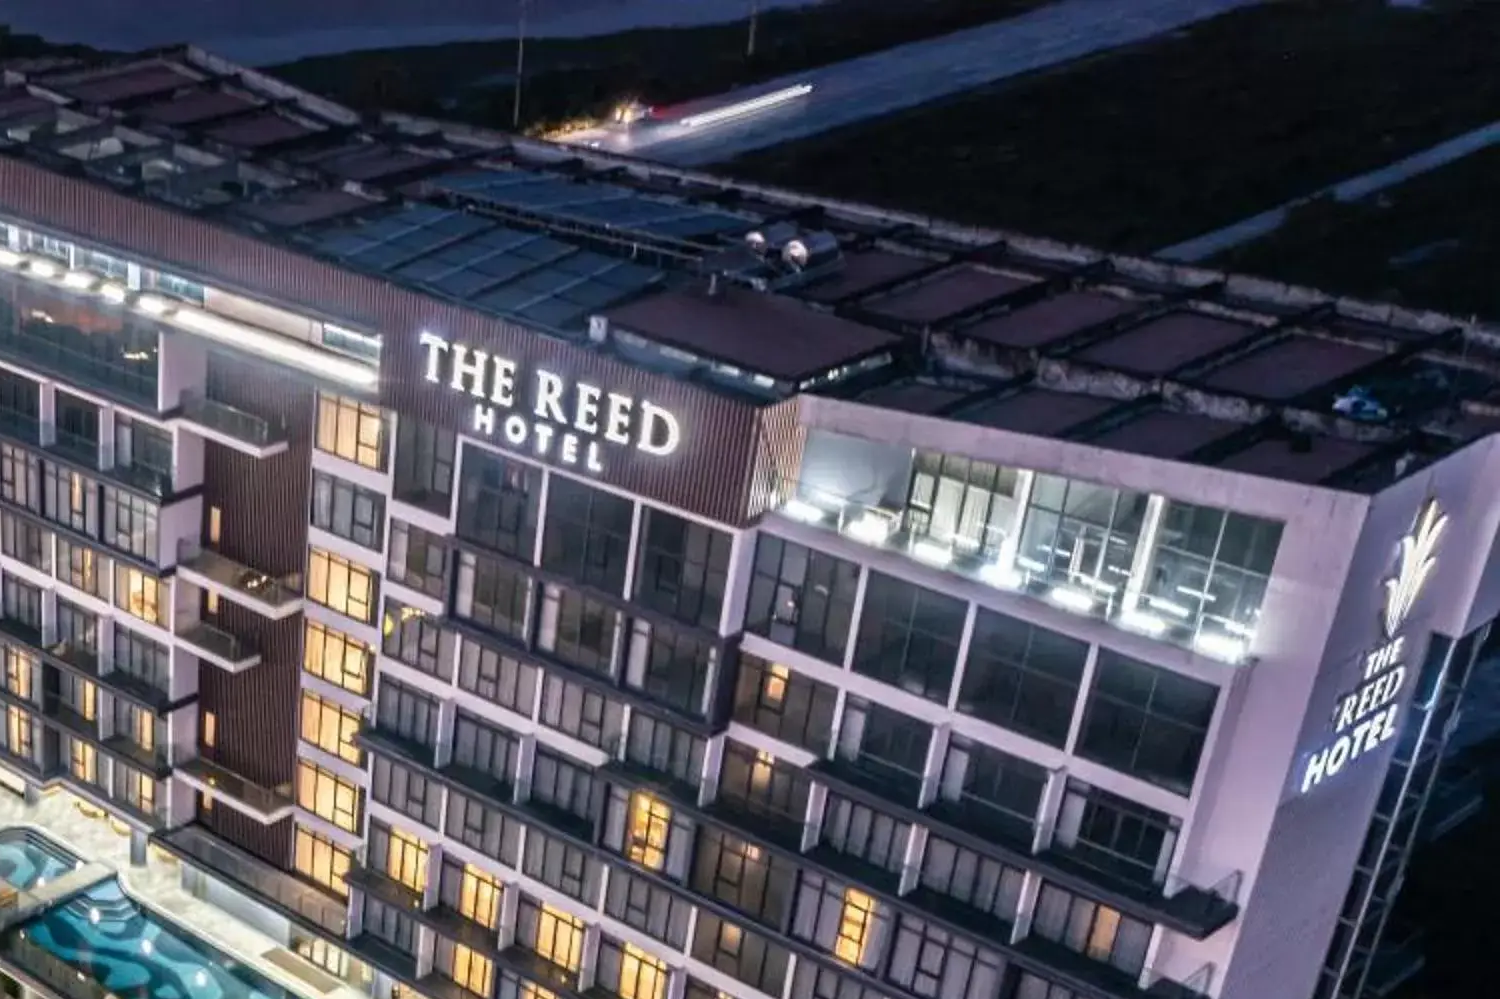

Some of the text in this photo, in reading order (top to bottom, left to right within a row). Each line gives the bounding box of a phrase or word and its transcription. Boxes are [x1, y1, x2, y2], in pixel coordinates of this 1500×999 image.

[419, 331, 680, 456] THE REED
[474, 403, 603, 472] HOTEL
[1364, 637, 1404, 680] THE
[1337, 667, 1406, 732] REED
[1301, 704, 1398, 793] HOTEL
